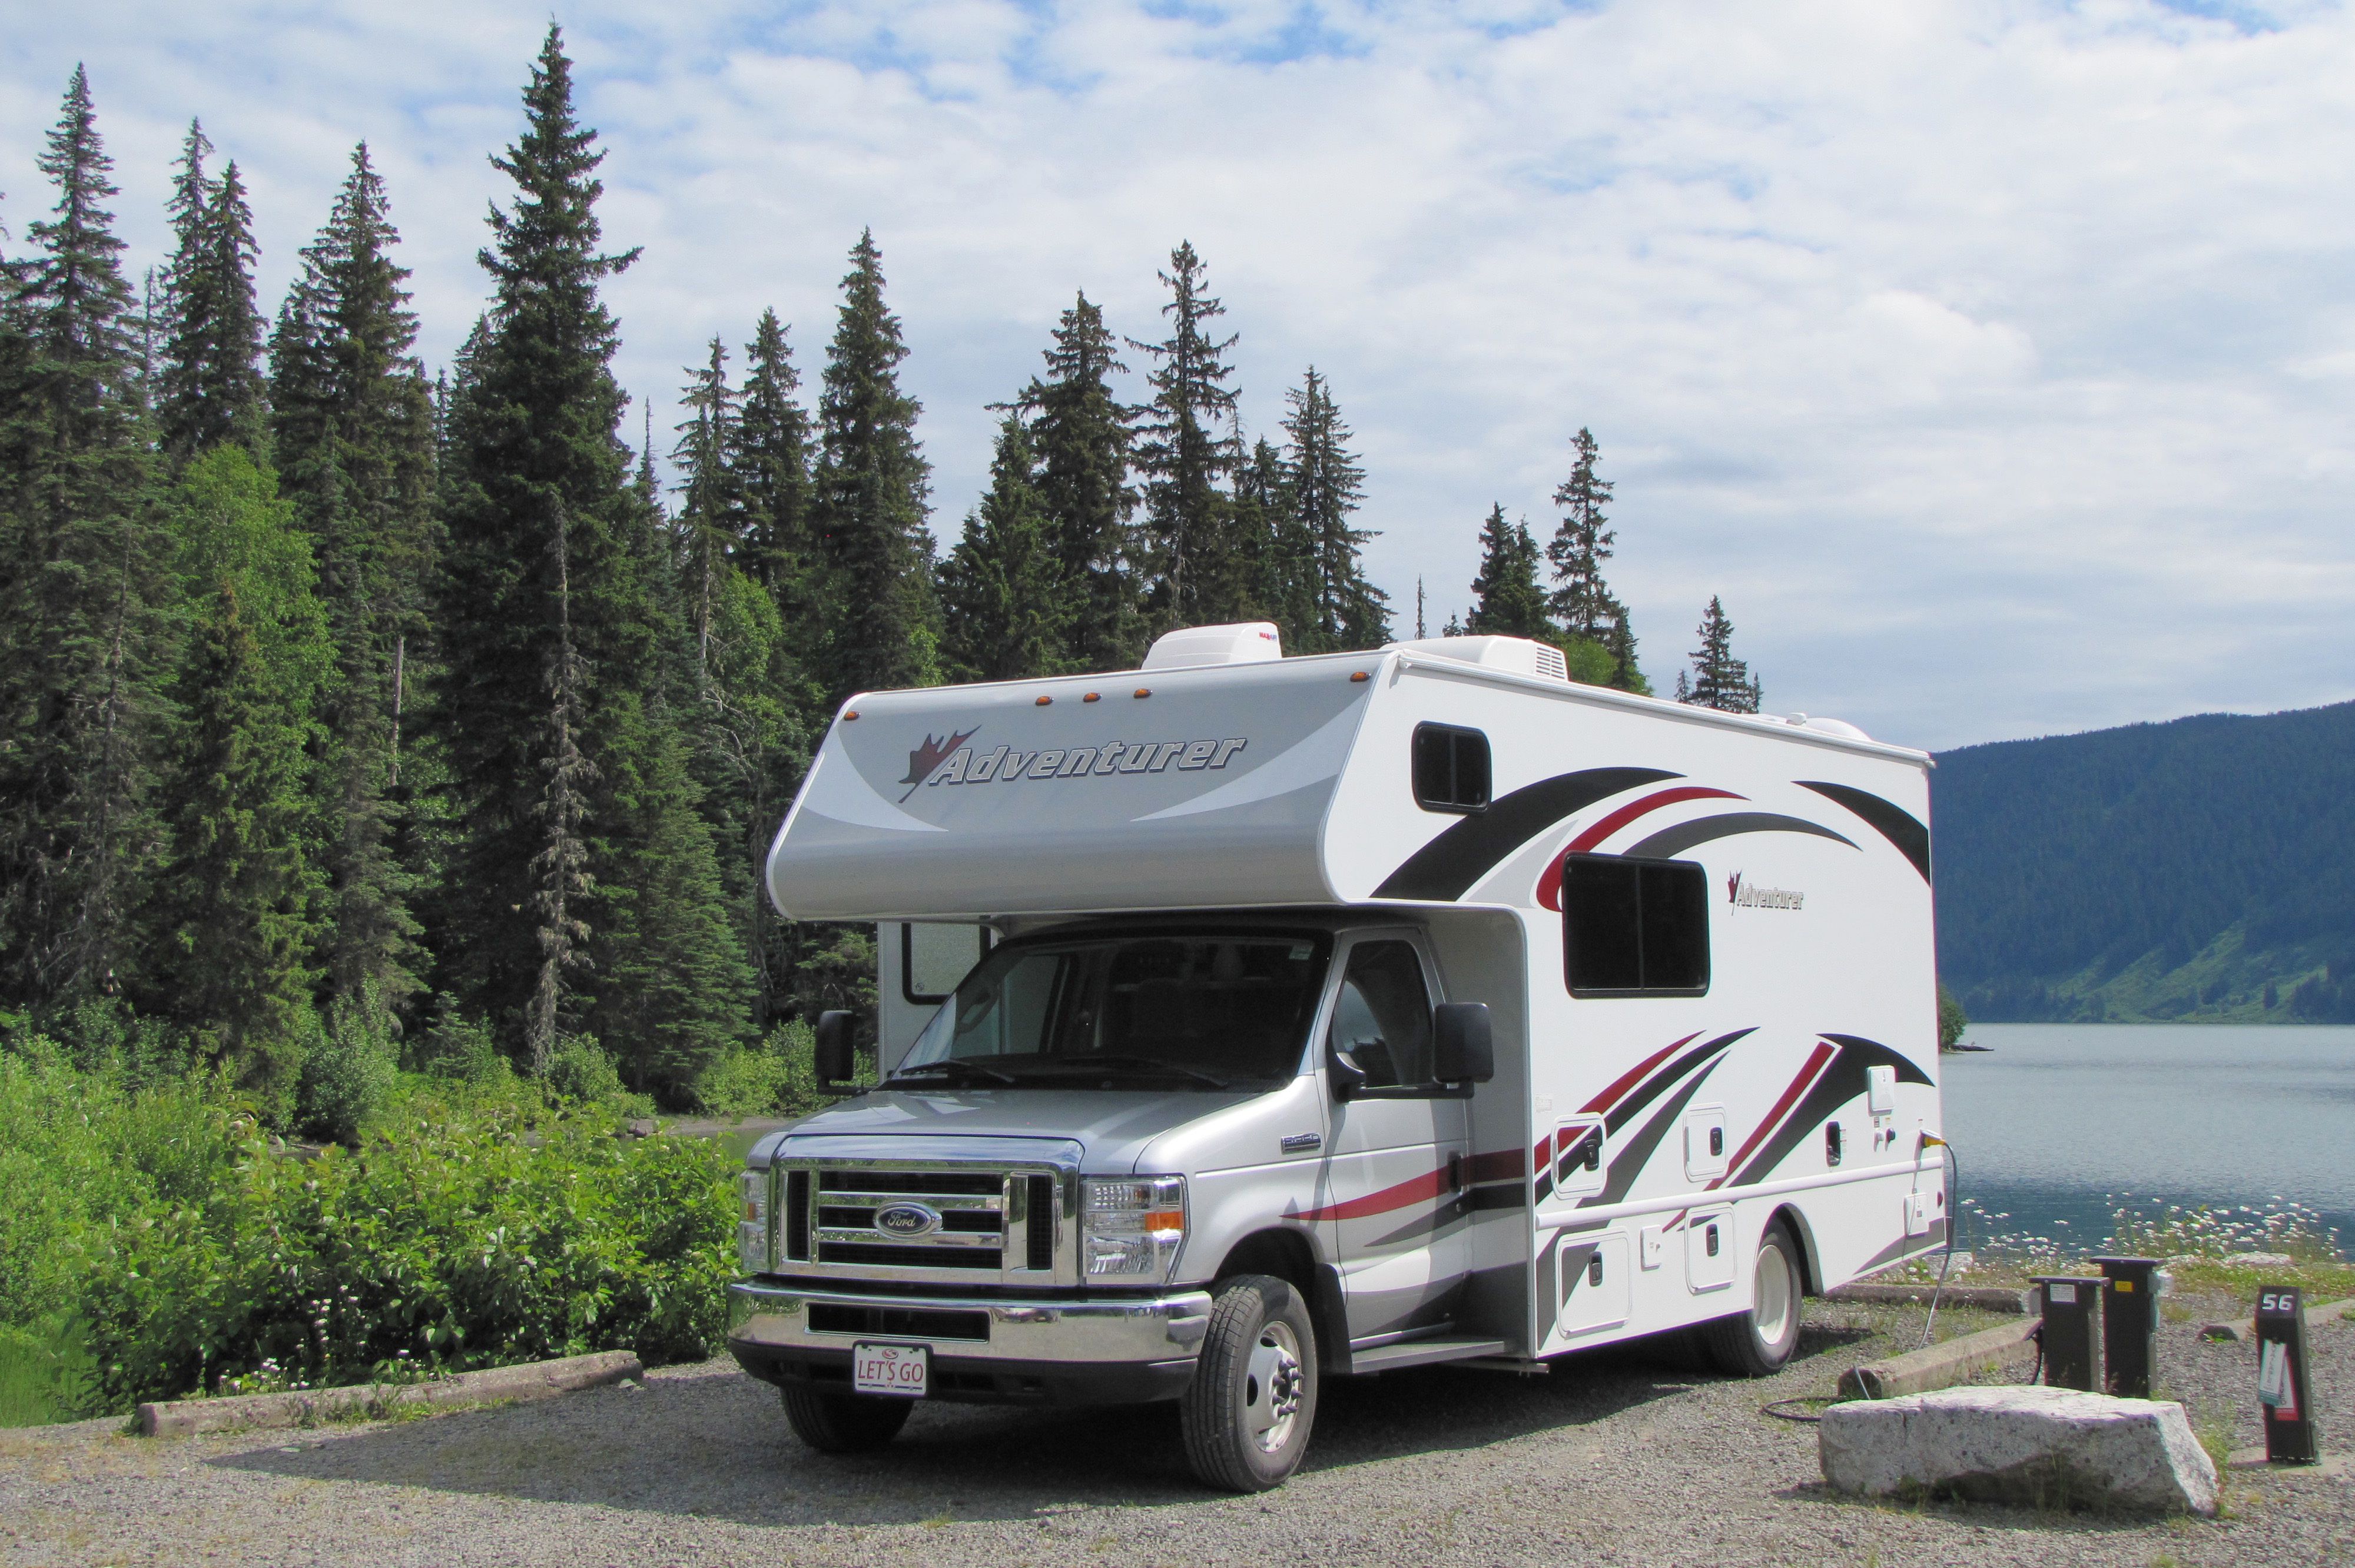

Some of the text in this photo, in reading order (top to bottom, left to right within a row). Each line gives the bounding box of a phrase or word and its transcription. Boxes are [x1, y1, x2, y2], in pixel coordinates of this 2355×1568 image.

[928, 738, 1248, 786] Adventurer
[1736, 882, 1804, 910] Adventurer
[887, 1211, 917, 1227] Ford
[2261, 1293, 2294, 1311] 56
[858, 1359, 924, 1383] LET'S GO
